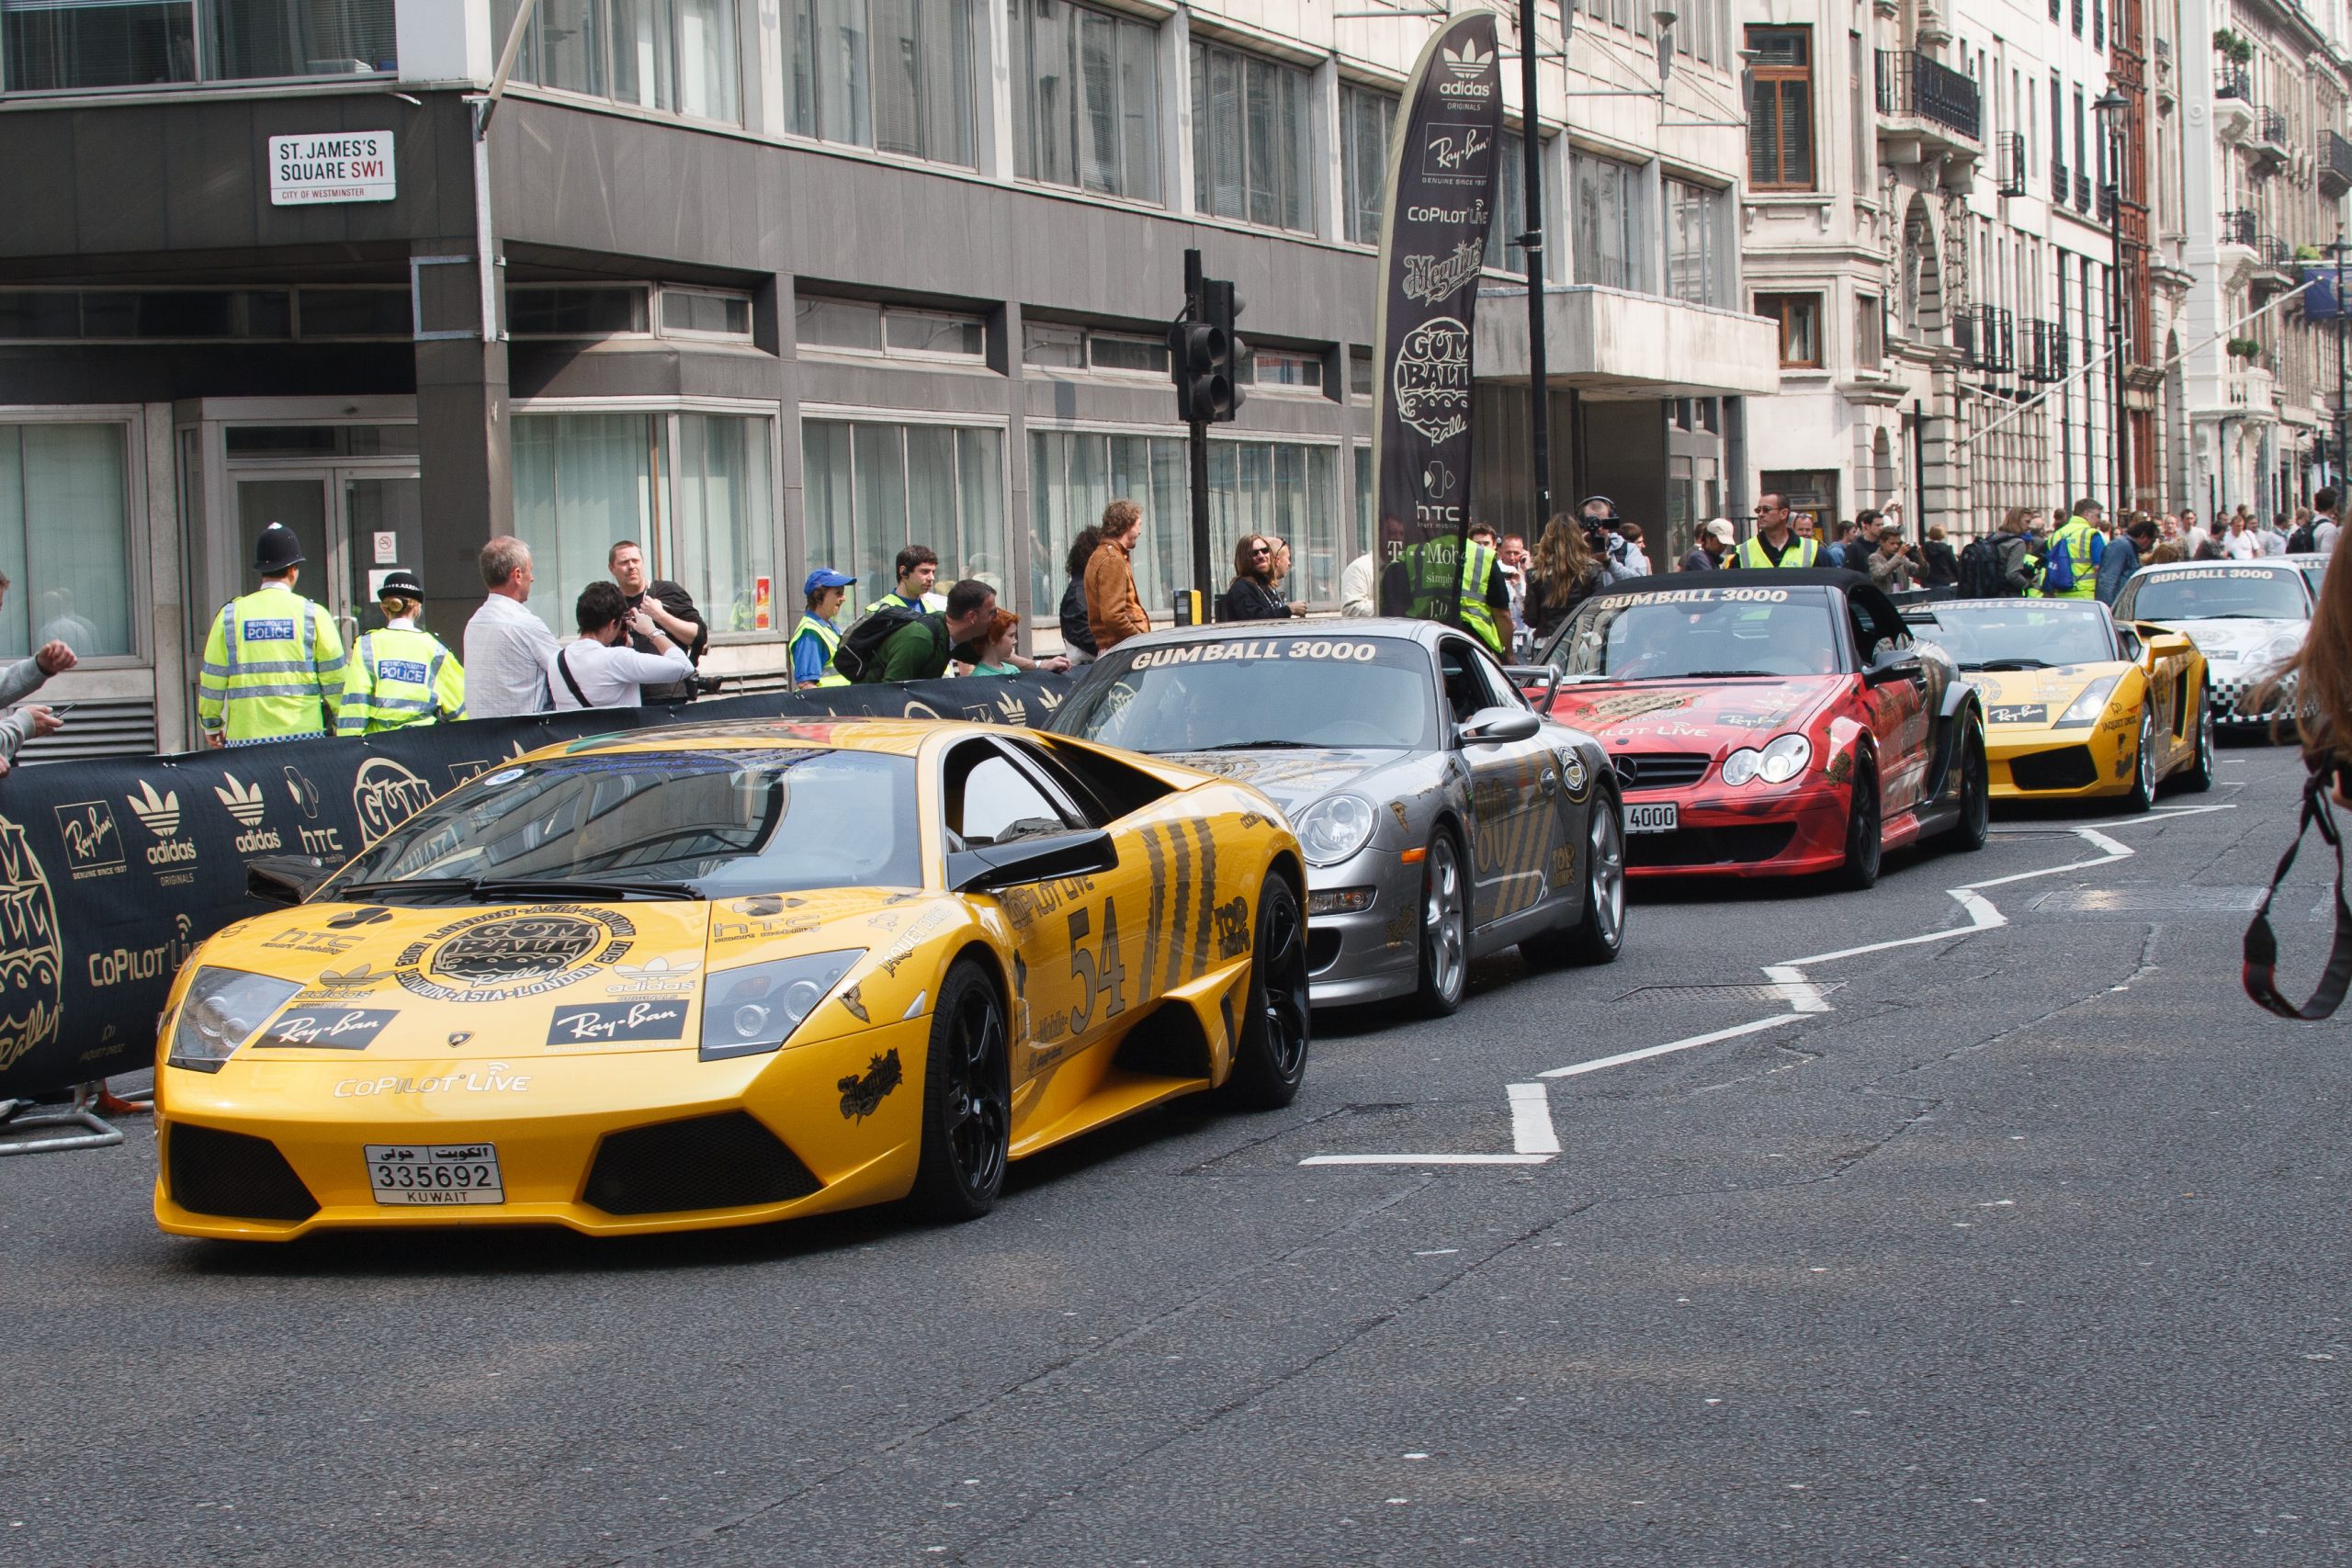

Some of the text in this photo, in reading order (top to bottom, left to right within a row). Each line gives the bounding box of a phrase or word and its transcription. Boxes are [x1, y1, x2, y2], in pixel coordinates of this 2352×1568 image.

[1440, 81, 1489, 96] adidas
[1447, 103, 1481, 111] ORIGINALS
[279, 139, 378, 160] ST. JAMES'S
[1429, 129, 1487, 169] Ray-Ban
[280, 160, 384, 181] SQUARE SW1
[282, 188, 365, 199] CITY OF WESTMINSTER
[1415, 501, 1460, 522] htc
[2150, 569, 2273, 585] GUMBALL 3000
[1600, 589, 1788, 610] GUMBALL 3000
[1908, 601, 2069, 614] GUMBALL 3000
[247, 626, 291, 640] POLICE
[1132, 641, 1376, 670] GUMBALL 3000
[380, 668, 424, 682] POLICE
[1990, 705, 2044, 722] Ray-Ban
[1657, 724, 1710, 737] LIVE
[1631, 807, 1674, 828] 4000
[64, 807, 113, 859] Ray-Ban
[235, 829, 281, 853] adidas
[298, 825, 344, 854] htc
[146, 838, 197, 864] adidas
[73, 870, 96, 880] GENUINE
[98, 867, 114, 876] SINCE
[160, 873, 195, 886] ORIGINALS
[424, 908, 517, 940] LONDON
[586, 908, 636, 938] LONDON
[714, 915, 820, 938] htc
[1214, 897, 1249, 940] TOP
[269, 927, 366, 949] htc
[761, 927, 821, 938] mobility
[395, 942, 433, 967] 2007
[594, 941, 635, 965] 2007
[877, 924, 926, 978] JAQUET
[472, 965, 559, 987] Rally
[1068, 896, 1125, 1035] 54
[295, 987, 373, 999] adidas
[395, 963, 605, 1003] LONDON ASIA LONDON
[605, 980, 695, 993] adidas
[275, 1010, 379, 1043] Ray-Ban
[557, 1002, 677, 1039] Ray-Ban
[466, 1072, 532, 1092] LIVE
[435, 1146, 489, 1161] الكويت
[379, 1165, 492, 1189] 335692
[407, 1191, 469, 1203] KUWAIT
